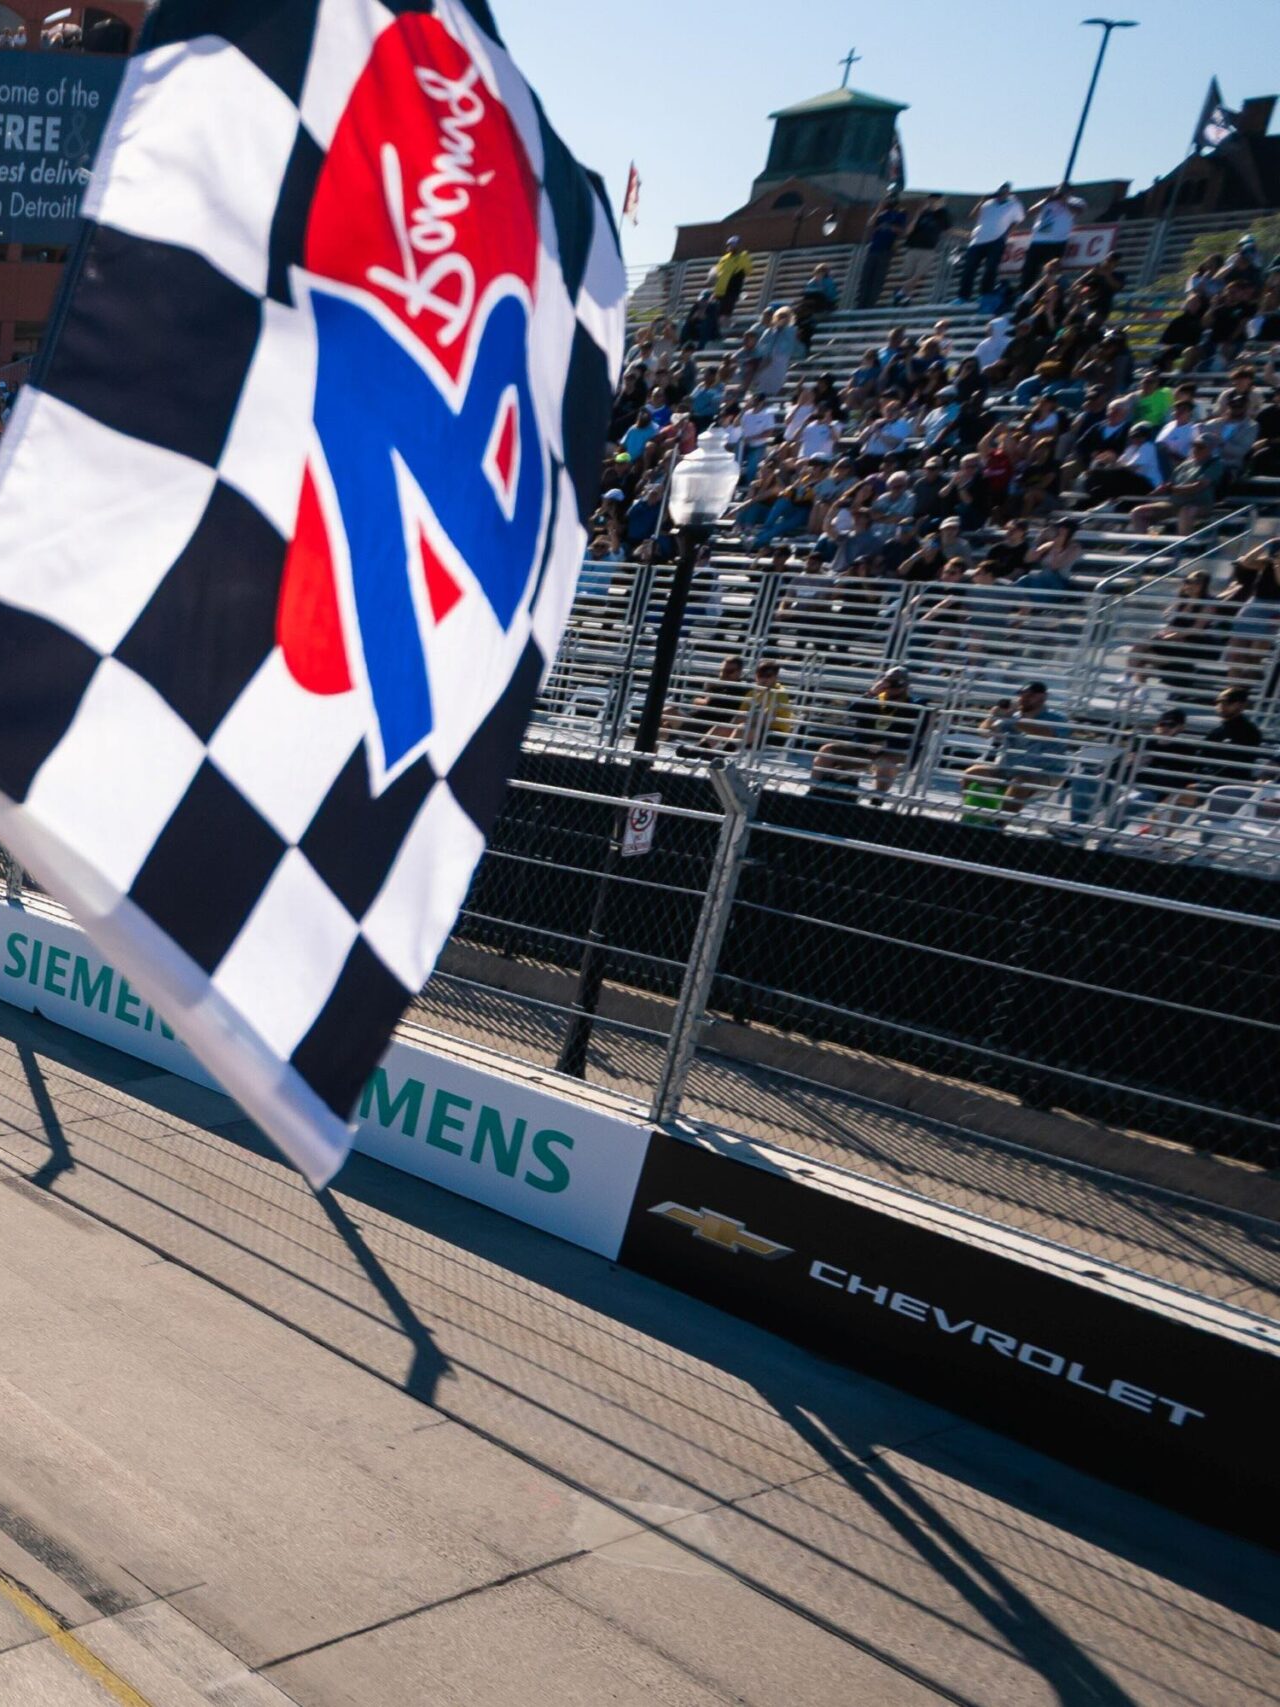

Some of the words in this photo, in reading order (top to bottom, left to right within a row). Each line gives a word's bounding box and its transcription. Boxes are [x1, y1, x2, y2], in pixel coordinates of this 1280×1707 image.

[46, 77, 68, 106] of
[70, 79, 100, 108] the
[9, 191, 78, 219] Detroit!
[30, 157, 92, 185] delive
[4, 932, 186, 1046] SIEME
[359, 1066, 575, 1194] MENS
[808, 1259, 1206, 1427] CHEVROLET
